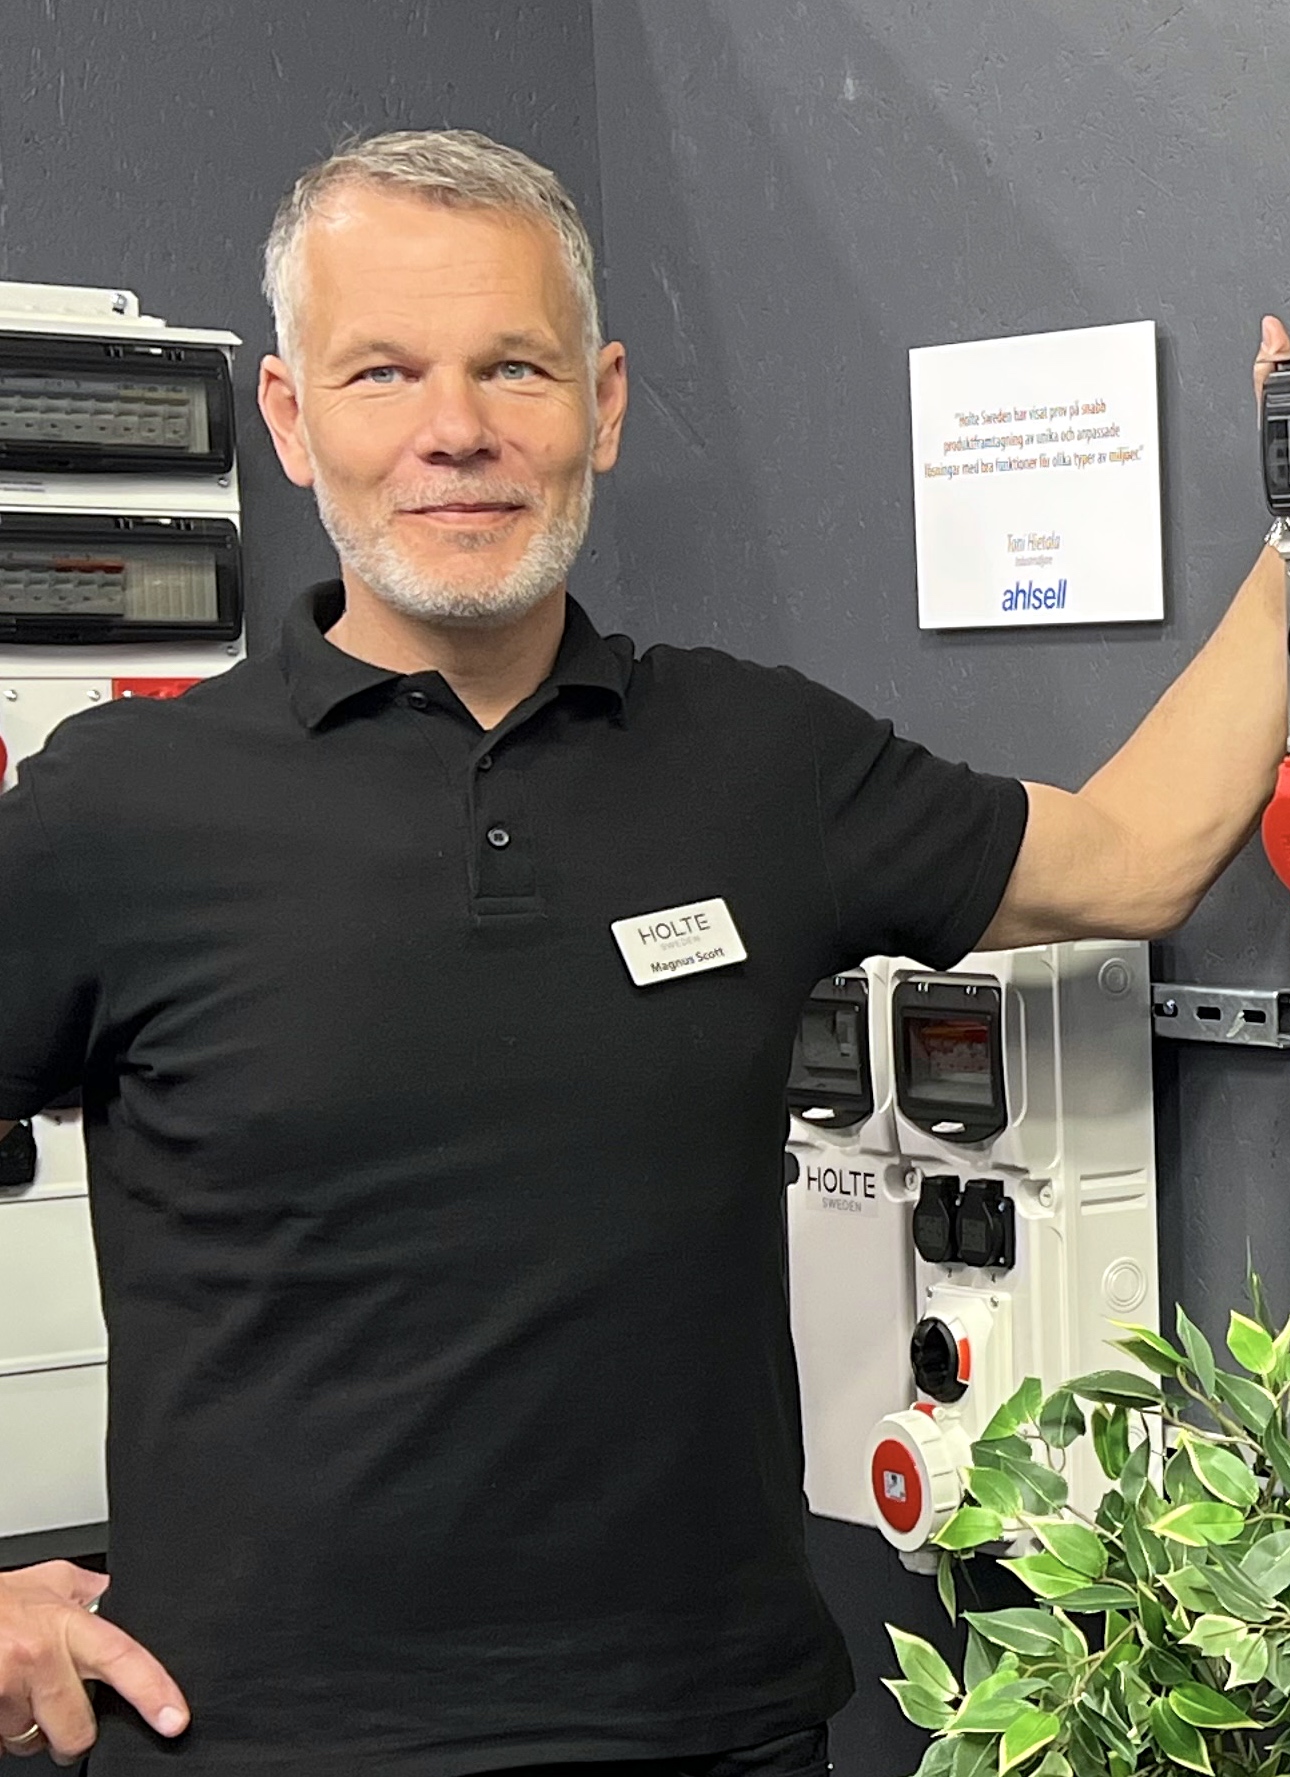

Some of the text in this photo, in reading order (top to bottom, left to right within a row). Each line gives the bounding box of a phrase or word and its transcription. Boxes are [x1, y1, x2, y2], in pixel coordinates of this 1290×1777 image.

[1013, 406, 1027, 421] har
[1068, 399, 1080, 421] på
[961, 457, 979, 475] med
[1002, 578, 1068, 612] ahlsell
[637, 913, 711, 945] HOLTE
[650, 946, 726, 974] Magnus Scott
[806, 1165, 876, 1199] HOLTE
[822, 1197, 862, 1212] SWEDEN
